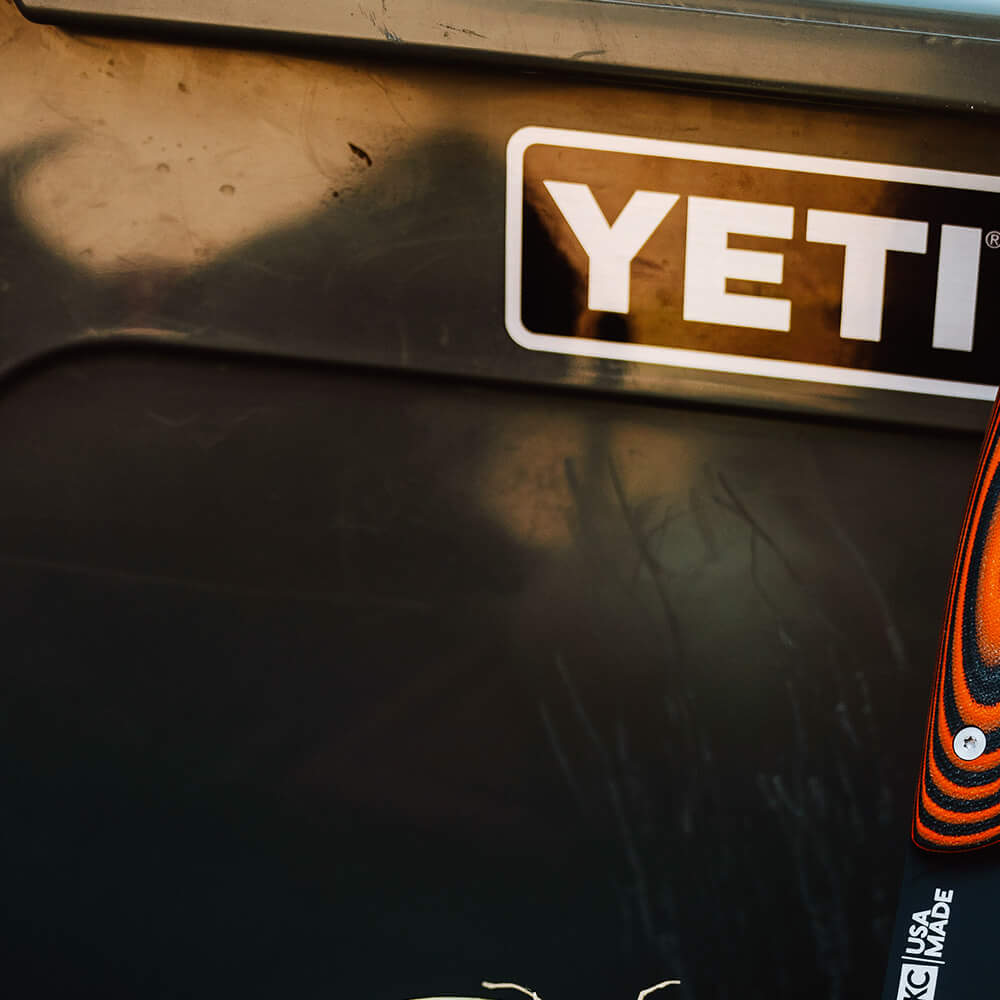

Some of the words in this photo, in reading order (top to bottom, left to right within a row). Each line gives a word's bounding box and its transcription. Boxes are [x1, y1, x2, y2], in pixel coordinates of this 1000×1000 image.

[543, 180, 983, 352] YETI
[905, 909, 932, 955] USA
[923, 888, 954, 958] MADE
